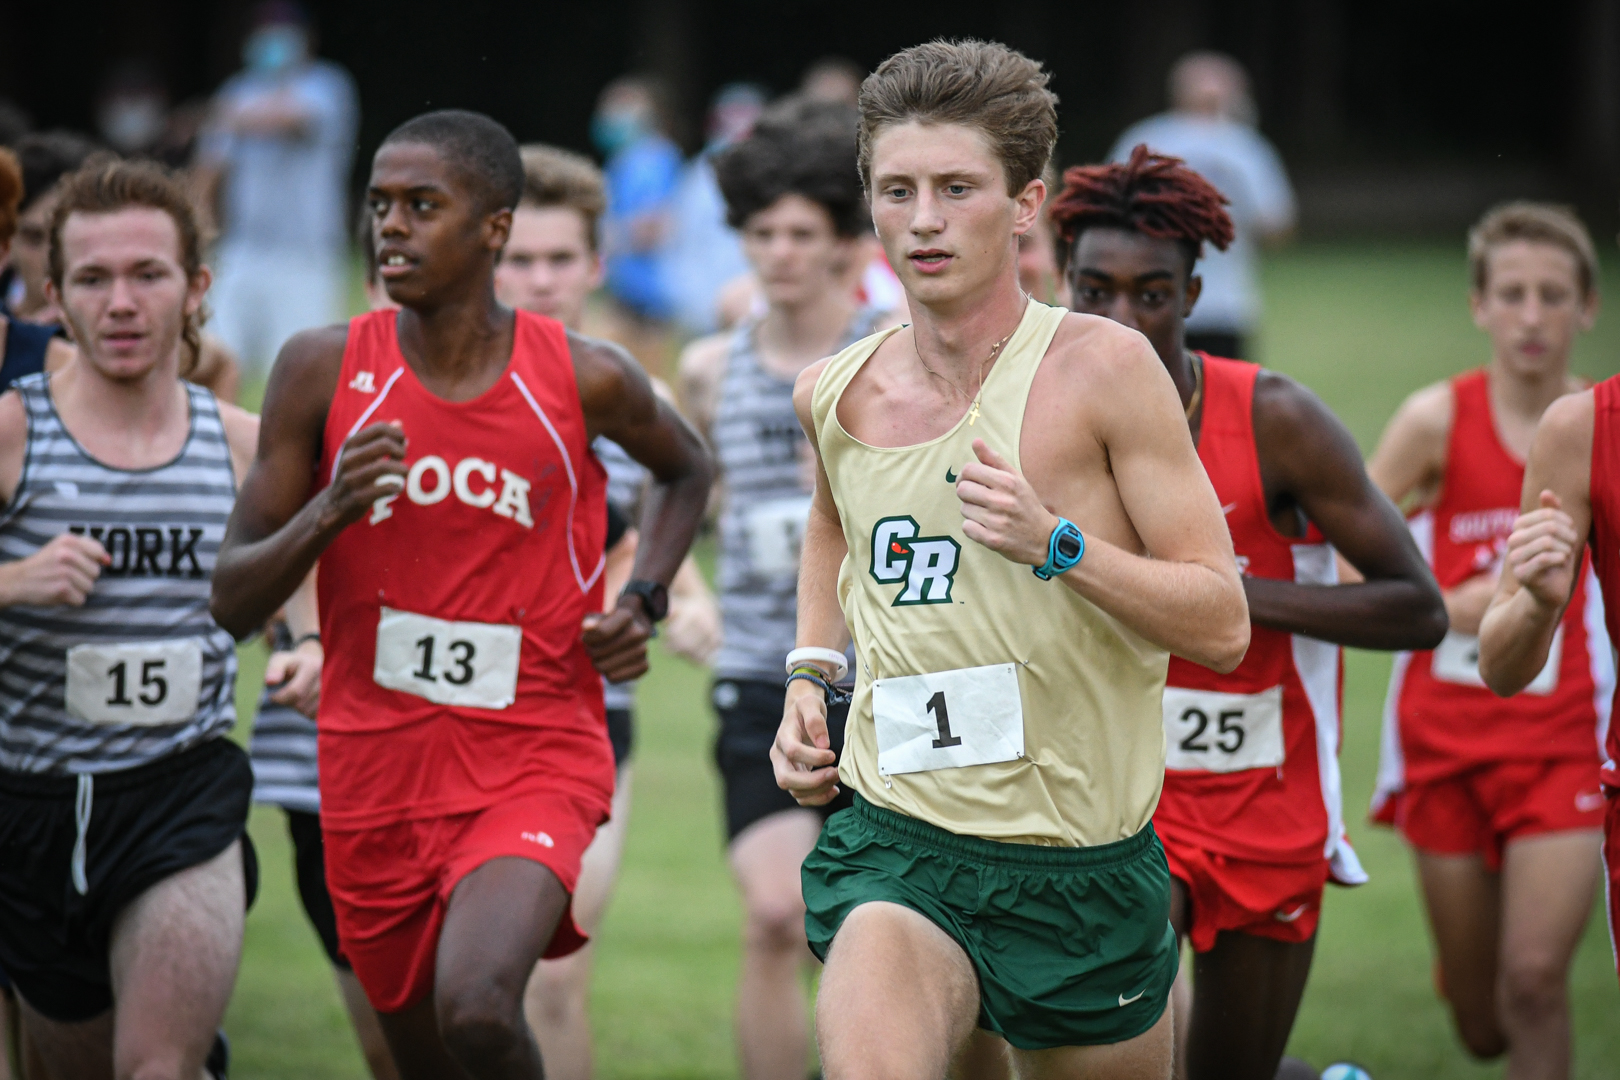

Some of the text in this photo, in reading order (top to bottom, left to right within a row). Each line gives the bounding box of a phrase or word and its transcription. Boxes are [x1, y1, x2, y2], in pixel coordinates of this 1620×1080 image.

[70, 526, 203, 577] ORK
[106, 660, 168, 705] 15
[412, 635, 476, 685] 13
[926, 691, 962, 749] 1
[1179, 708, 1246, 754] 25
